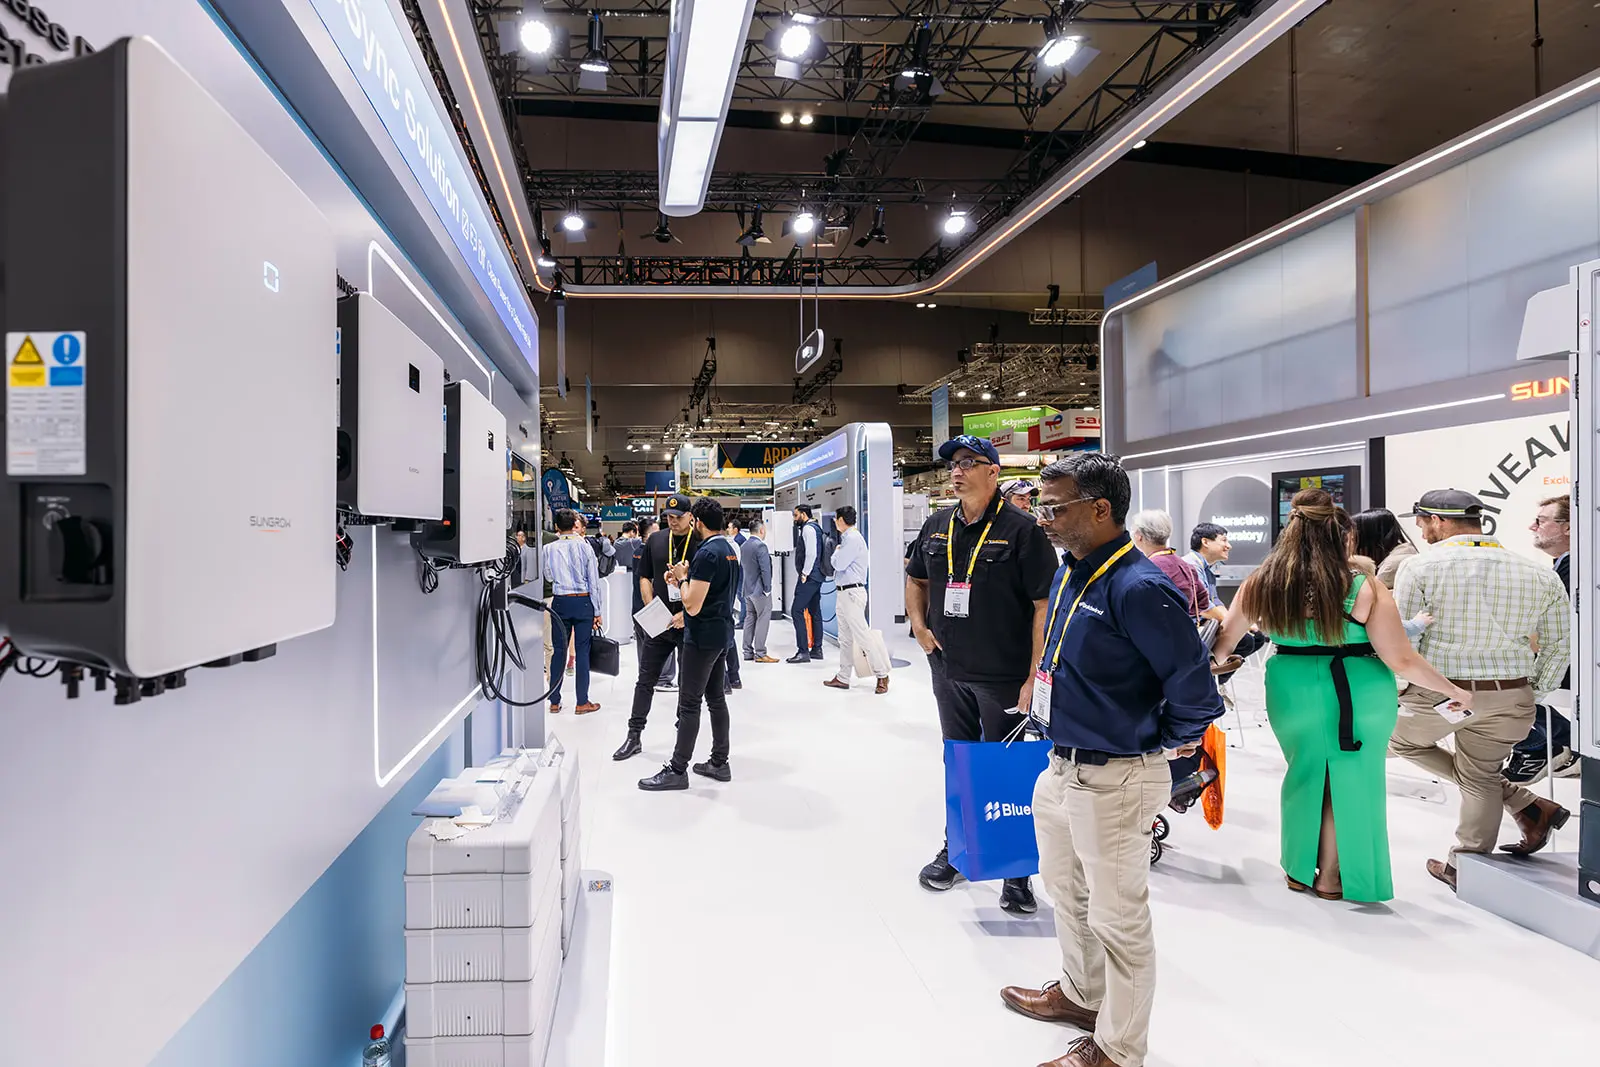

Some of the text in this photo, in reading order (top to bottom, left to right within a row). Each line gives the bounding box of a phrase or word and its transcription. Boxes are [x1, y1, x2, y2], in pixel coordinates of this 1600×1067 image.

[404, 87, 459, 222] Solution
[1511, 376, 1570, 401] SUN
[1075, 416, 1100, 424] sa
[763, 447, 801, 464] ARR
[249, 515, 292, 528] SUNGROW
[1211, 514, 1266, 526] Interactive
[1227, 530, 1264, 543] oratory
[1001, 803, 1031, 817] Blue
